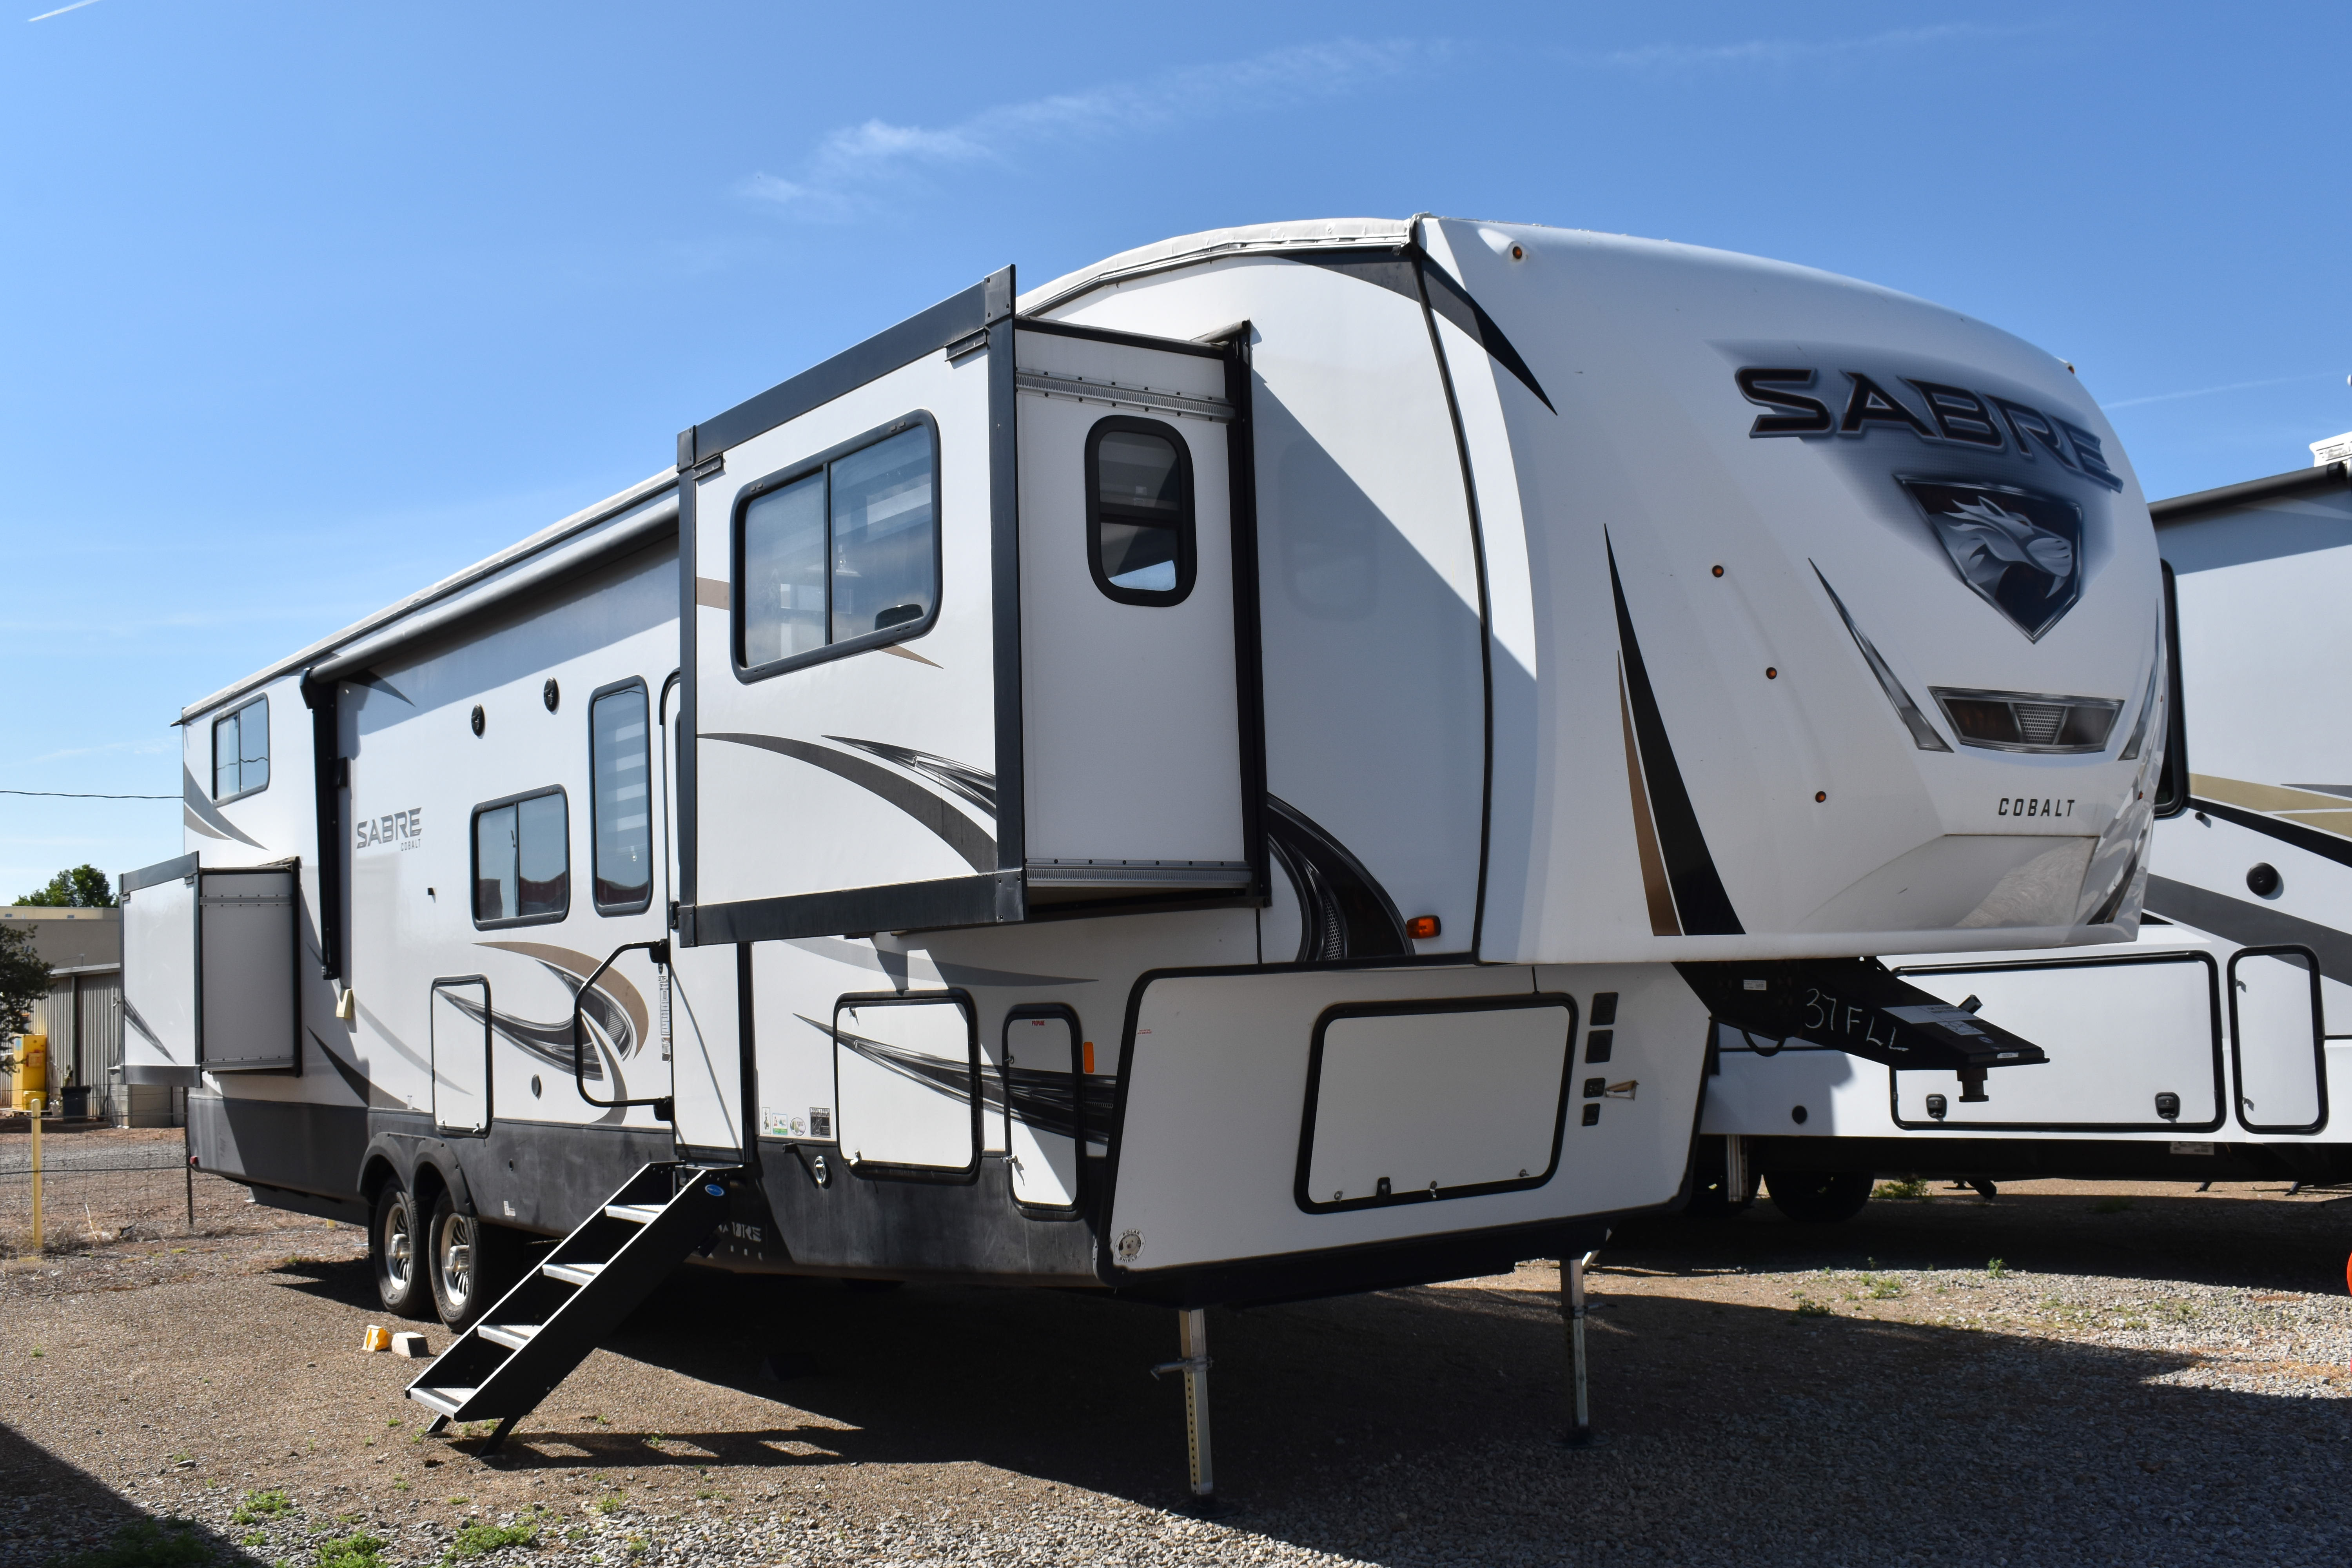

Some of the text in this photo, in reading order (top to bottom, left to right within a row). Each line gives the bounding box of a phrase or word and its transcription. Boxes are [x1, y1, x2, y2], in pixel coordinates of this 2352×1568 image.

[1735, 366, 2123, 493] SABRE
[1998, 798, 2075, 817] COBALT
[357, 807, 422, 849] SABRE
[401, 838, 421, 851] COBALT
